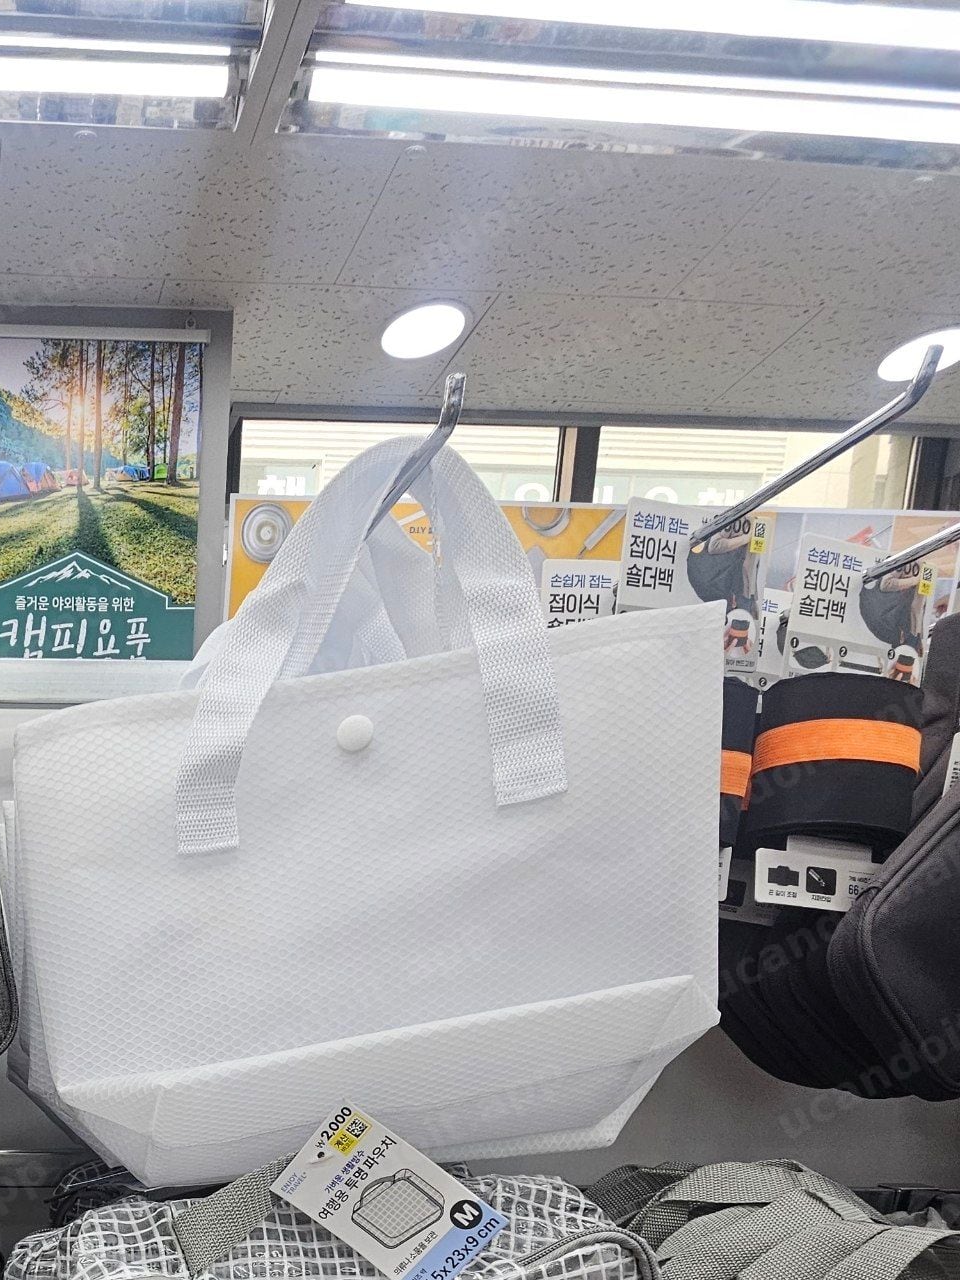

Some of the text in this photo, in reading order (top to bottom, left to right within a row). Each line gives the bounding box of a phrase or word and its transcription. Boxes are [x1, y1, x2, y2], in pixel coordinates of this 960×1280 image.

[633, 510, 666, 532] 손쉽게
[668, 517, 689, 536] 접는
[629, 534, 677, 564] 접이식
[808, 547, 840, 567] 손쉽게
[843, 553, 863, 572] 접는
[551, 574, 612, 589] 손쉽게 접는
[626, 564, 673, 592] 숄더백
[803, 568, 850, 597] 접이식
[15, 595, 135, 612] 즐거운 야외활동을 위한
[549, 593, 600, 614] 접이식
[799, 595, 846, 623] 숄더백
[341, 1150, 365, 1175] 생활방수
[280, 1172, 298, 1193] ENJOY
[318, 1135, 397, 1220] 여행용 투명 파우치
[453, 1203, 479, 1226] M
[477, 1218, 500, 1239] cm
